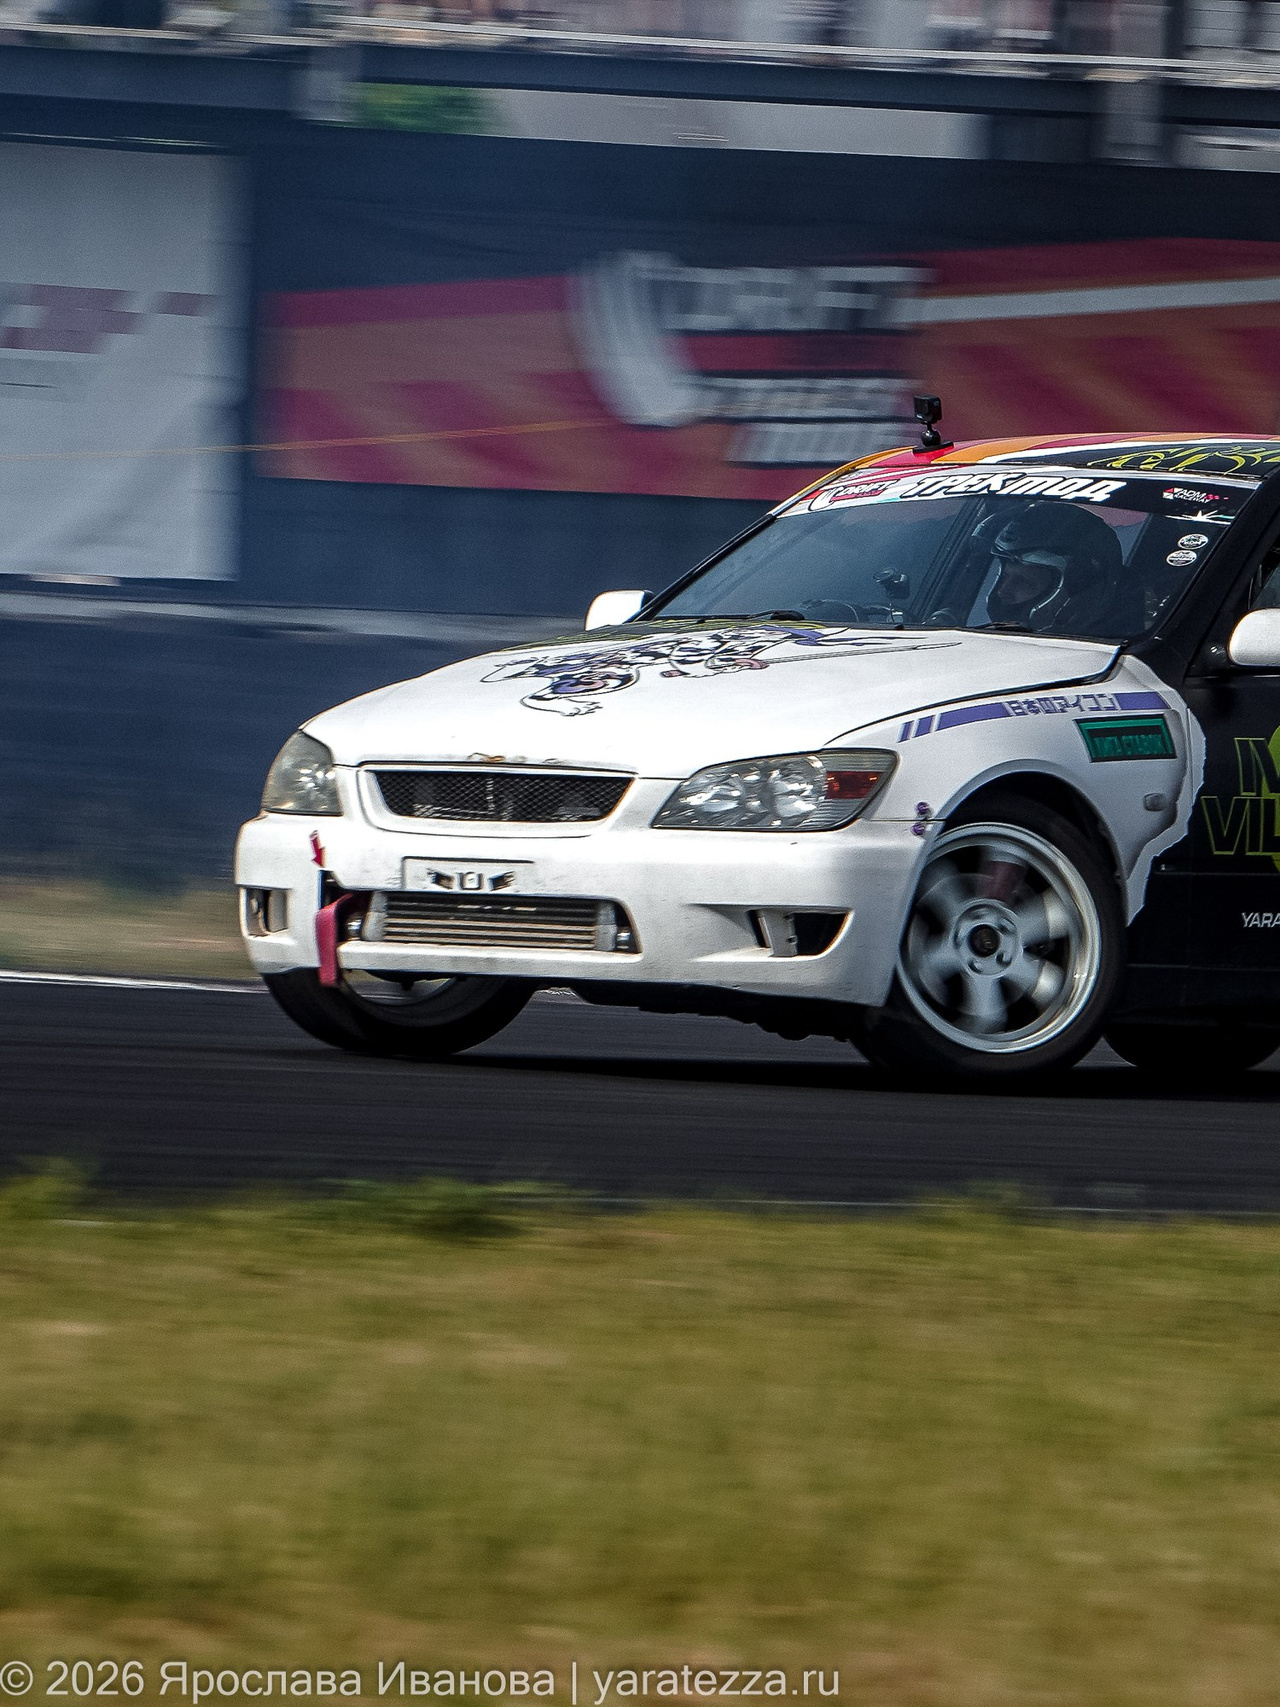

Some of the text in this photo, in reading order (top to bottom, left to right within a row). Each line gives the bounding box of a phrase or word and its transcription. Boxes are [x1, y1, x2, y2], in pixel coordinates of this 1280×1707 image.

[834, 480, 898, 497] DRIFT
[1177, 489, 1207, 499] ADM
[1174, 493, 1211, 504] RACEWAY
